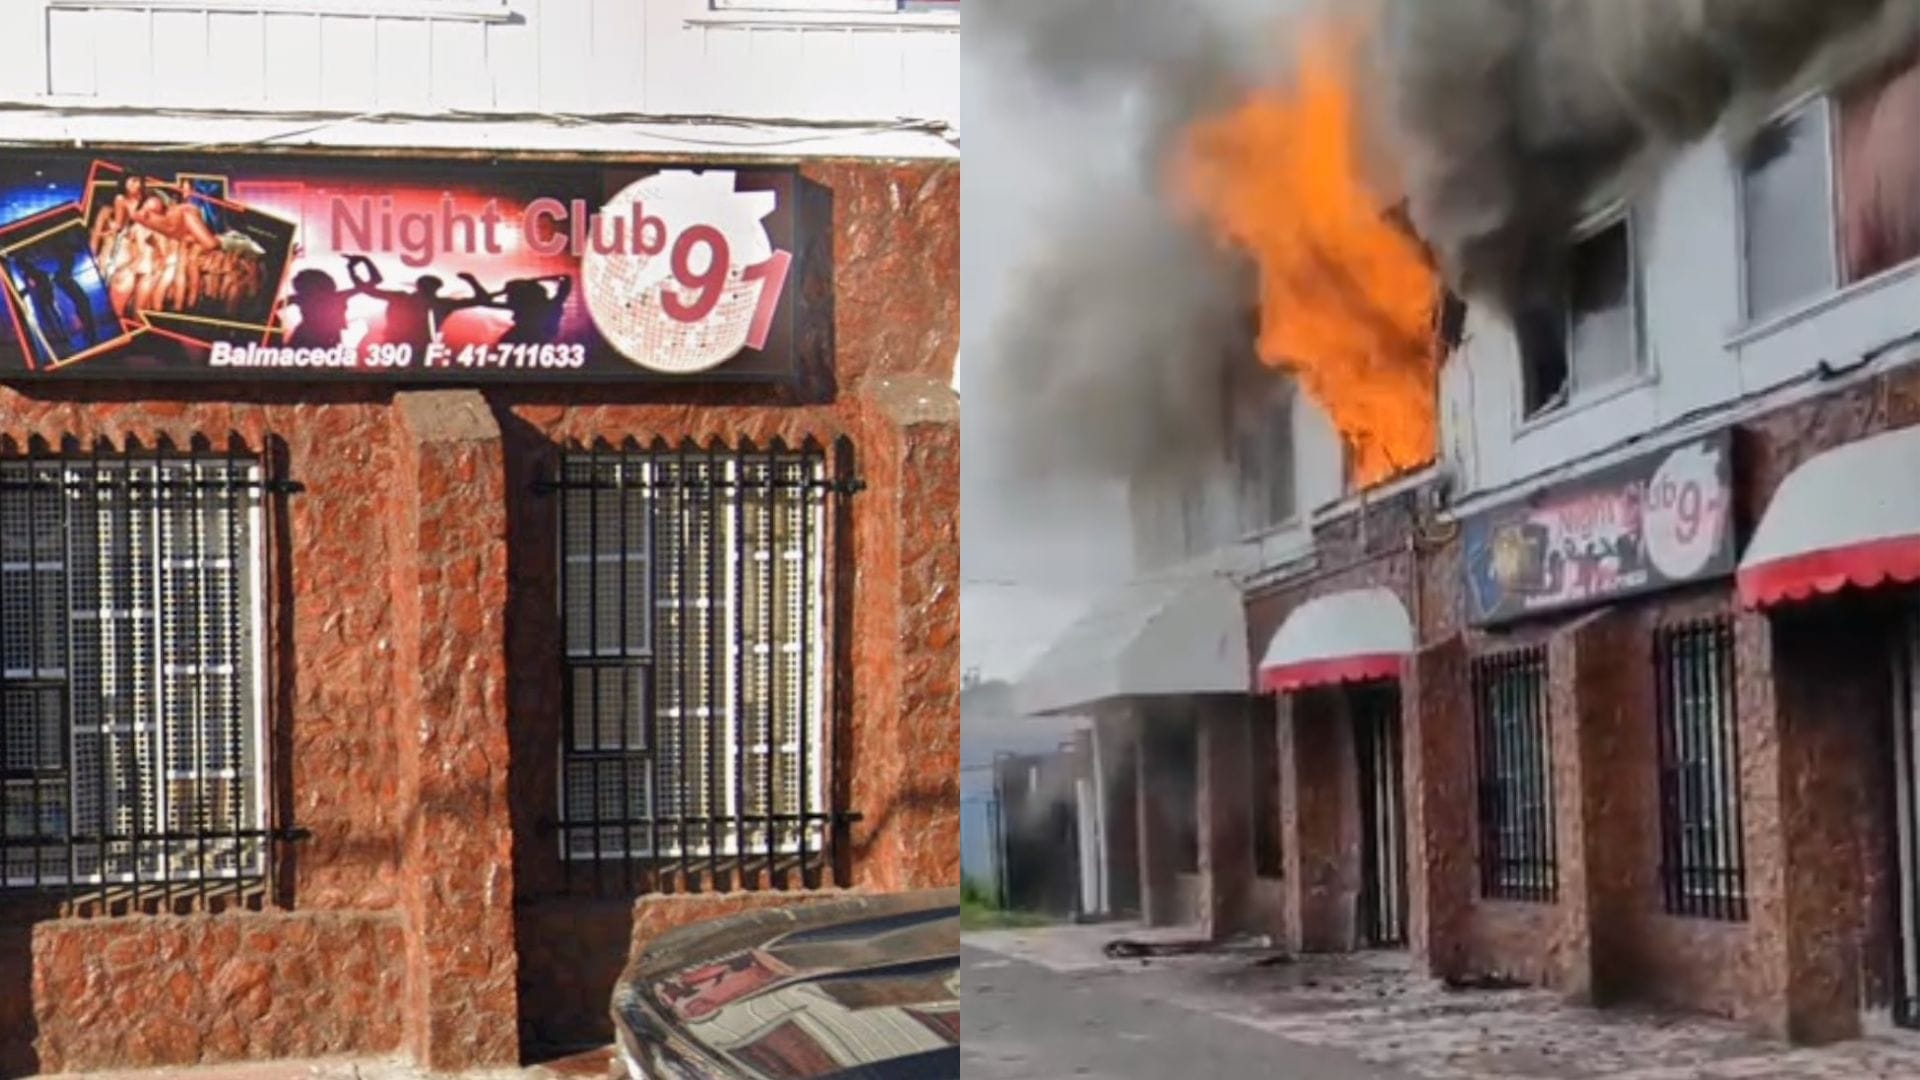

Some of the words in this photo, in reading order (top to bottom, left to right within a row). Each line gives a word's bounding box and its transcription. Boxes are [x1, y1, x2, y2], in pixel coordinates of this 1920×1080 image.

[332, 191, 501, 267] Night
[523, 198, 667, 257] Club
[660, 223, 794, 351] 91
[209, 341, 356, 368] Balmaceda
[364, 343, 412, 368] 390
[423, 342, 450, 368] F:
[456, 343, 585, 368] 41-711633
